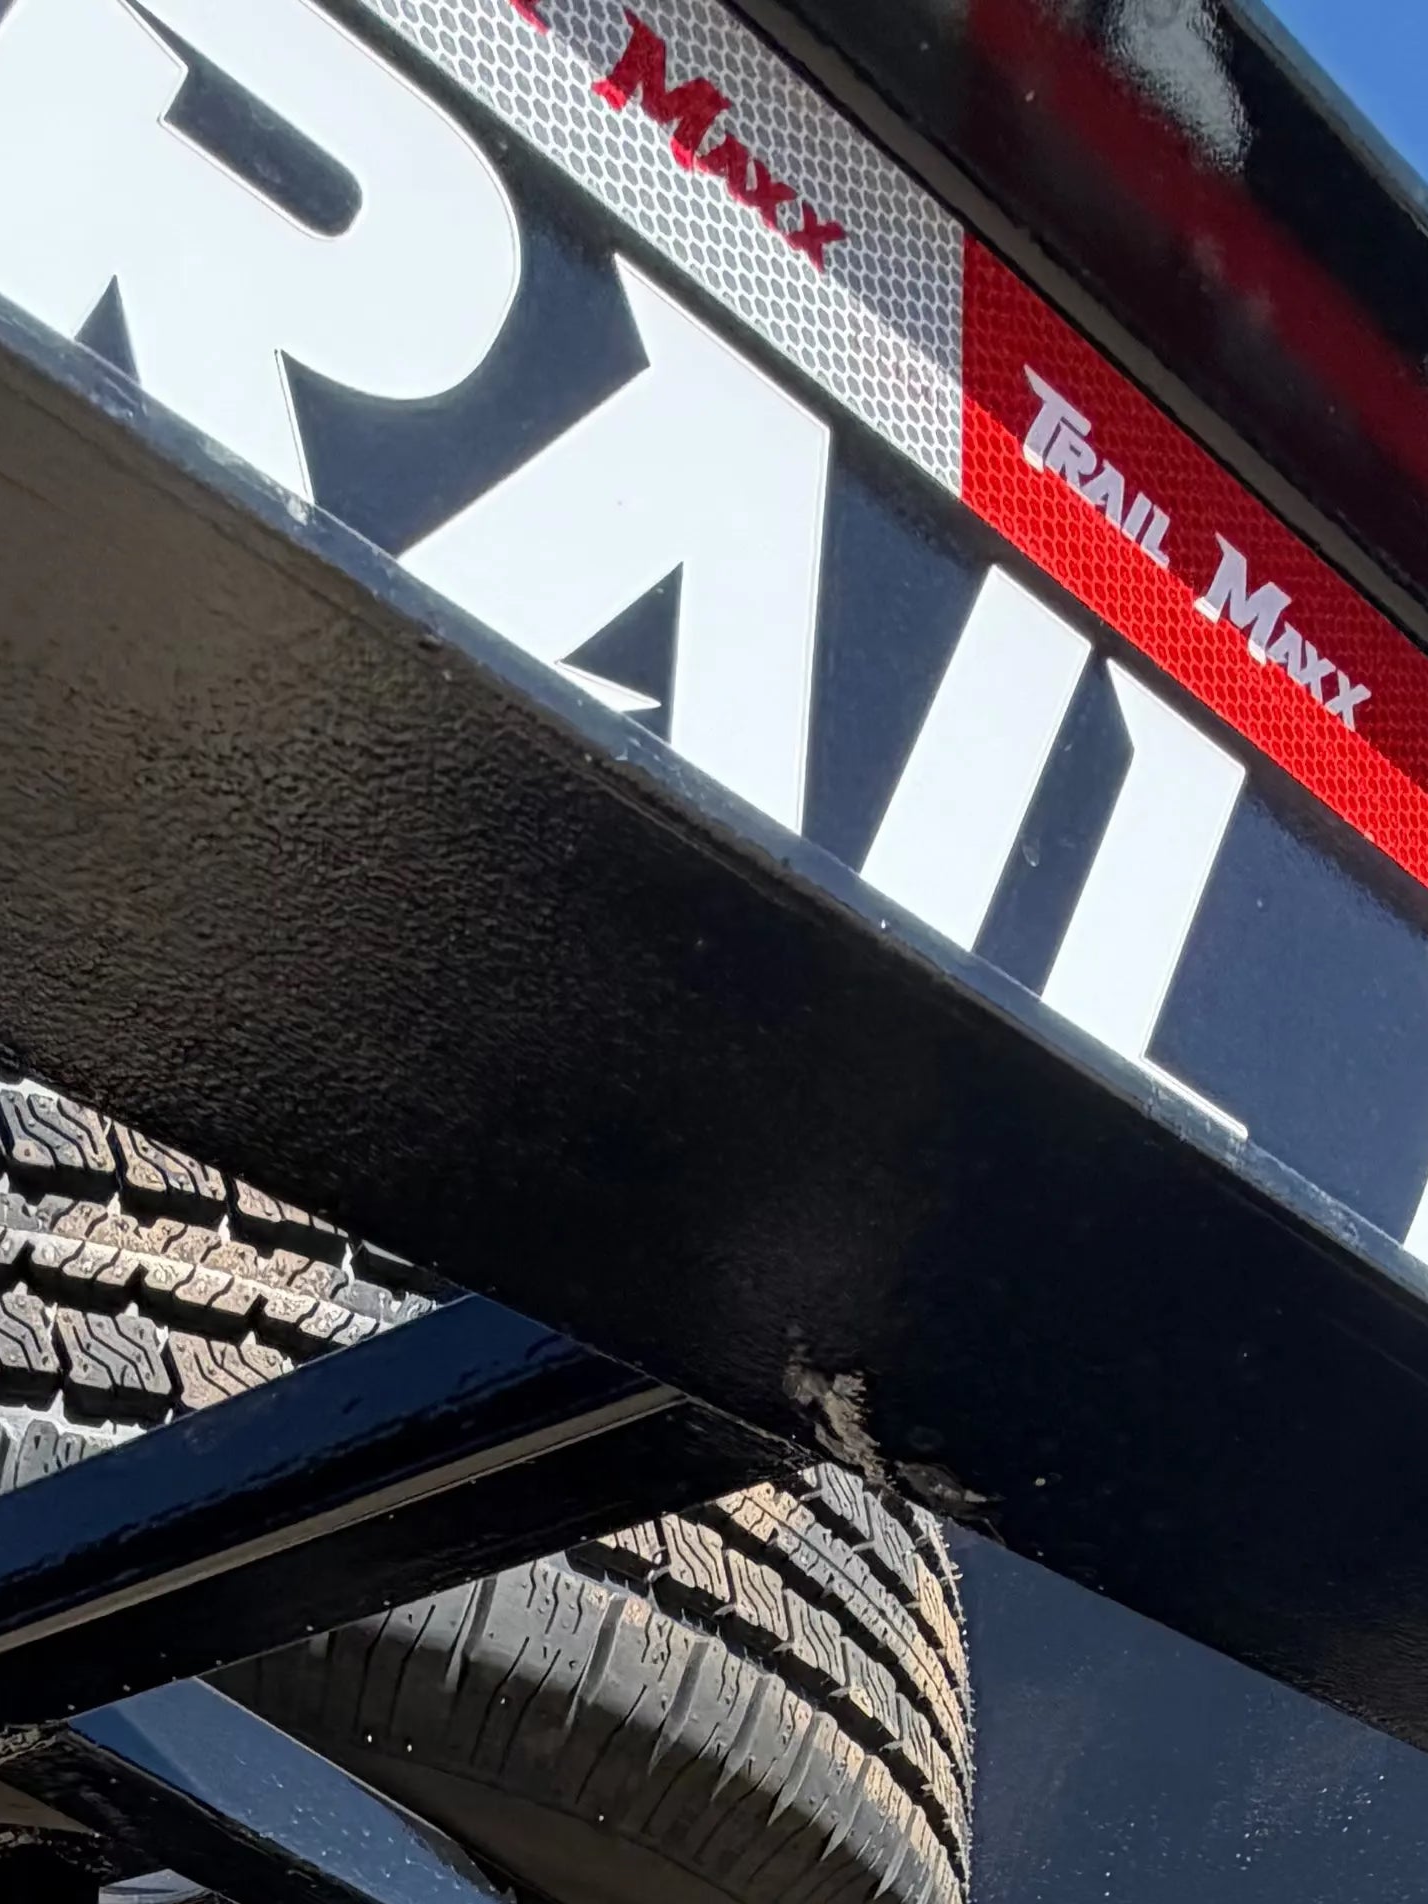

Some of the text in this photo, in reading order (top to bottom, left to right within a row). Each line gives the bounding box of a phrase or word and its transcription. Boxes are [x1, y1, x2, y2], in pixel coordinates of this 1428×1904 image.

[592, 8, 846, 272] MAXX
[1022, 363, 1372, 732] TRAIL MAXX
